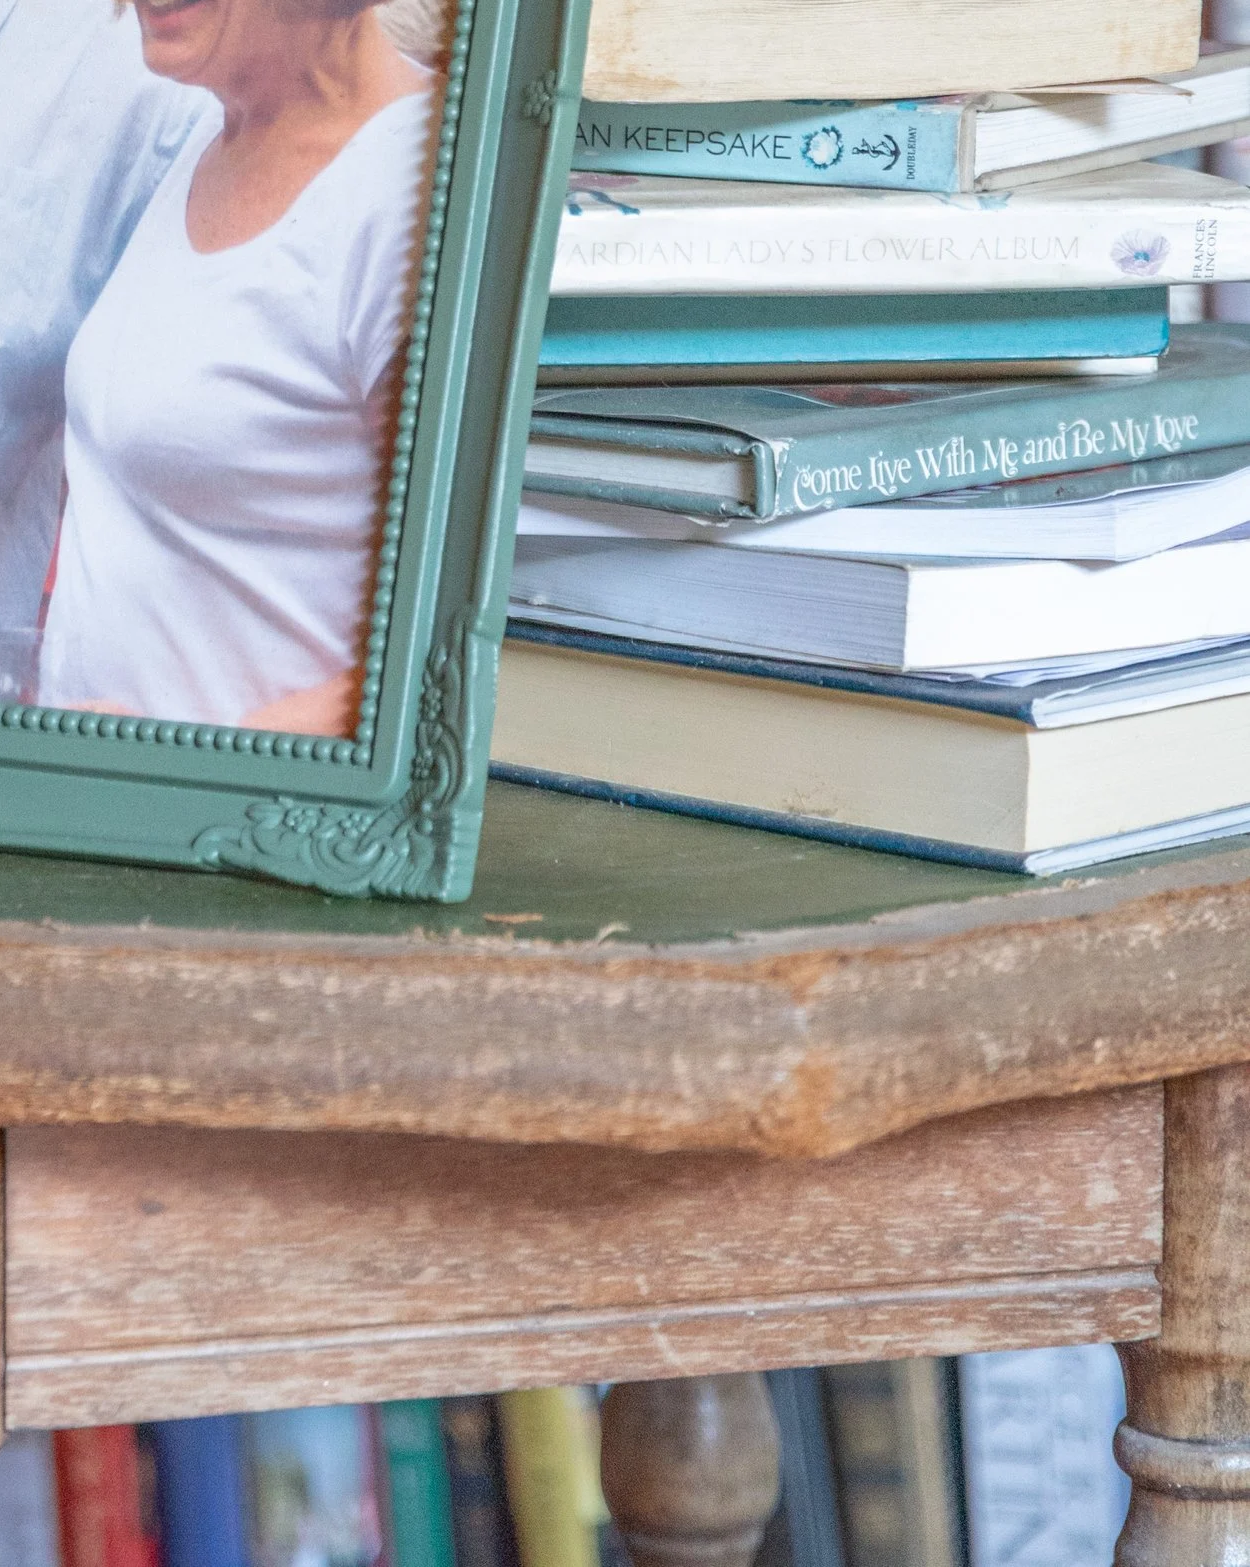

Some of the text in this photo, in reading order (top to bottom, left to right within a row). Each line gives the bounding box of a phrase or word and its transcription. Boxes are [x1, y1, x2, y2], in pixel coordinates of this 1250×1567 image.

[623, 125, 793, 160] KEEPSAKE
[906, 125, 918, 180] DOUBLEDAY
[556, 238, 693, 266] ARDIAN
[827, 236, 962, 264] FLOWER
[969, 235, 1081, 262] ALBUM
[1192, 218, 1206, 279] FRANCES
[1204, 218, 1218, 279] LINCOLN
[793, 414, 1199, 511] Come Live With Me and Be My Love
